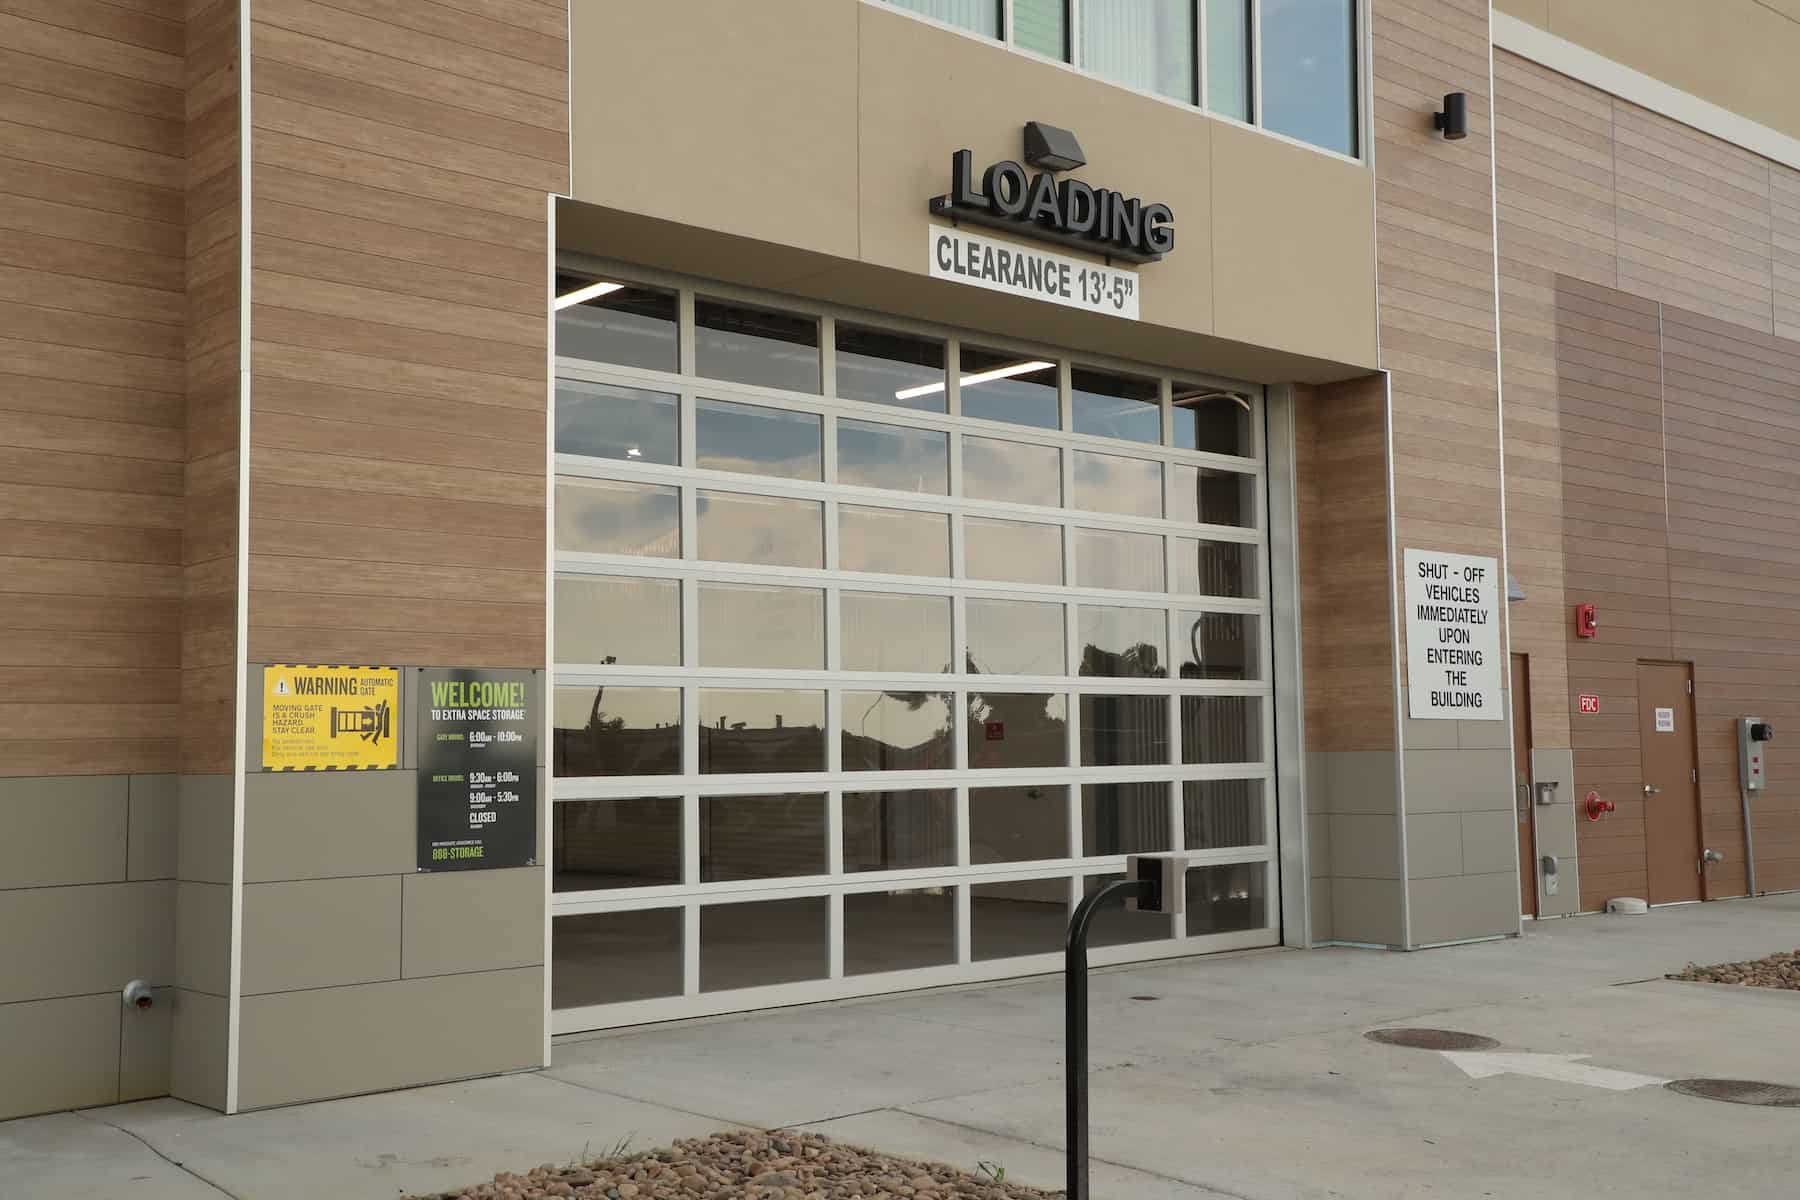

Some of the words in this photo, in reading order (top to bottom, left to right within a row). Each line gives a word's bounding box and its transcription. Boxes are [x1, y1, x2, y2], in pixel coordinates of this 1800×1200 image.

[953, 149, 1174, 254] LOADING
[936, 235, 1071, 298] CLEARANCE
[1418, 562, 1448, 579] SHUT
[1464, 567, 1485, 583] OFF
[1425, 584, 1480, 603] VEHICLES
[1417, 605, 1488, 624] IMMEDIATELY
[1439, 628, 1470, 644] UPON
[1427, 648, 1483, 665] ENTERING
[294, 676, 357, 695] WARNING
[360, 678, 393, 686] AUTOMATIC
[1445, 670, 1467, 686] THE
[360, 687, 375, 696] GATE
[431, 681, 525, 707] WELCOME!
[1431, 691, 1482, 707] BUILDING
[272, 704, 303, 712] MOVING
[304, 704, 323, 712] GATE
[1581, 697, 1597, 711] FDC
[288, 712, 315, 720] CRUSH
[431, 709, 441, 720] TO
[442, 709, 466, 720] EXTRA
[467, 709, 491, 720] SPACE
[492, 709, 525, 720] STORAGE
[469, 811, 497, 823] CLOSED
